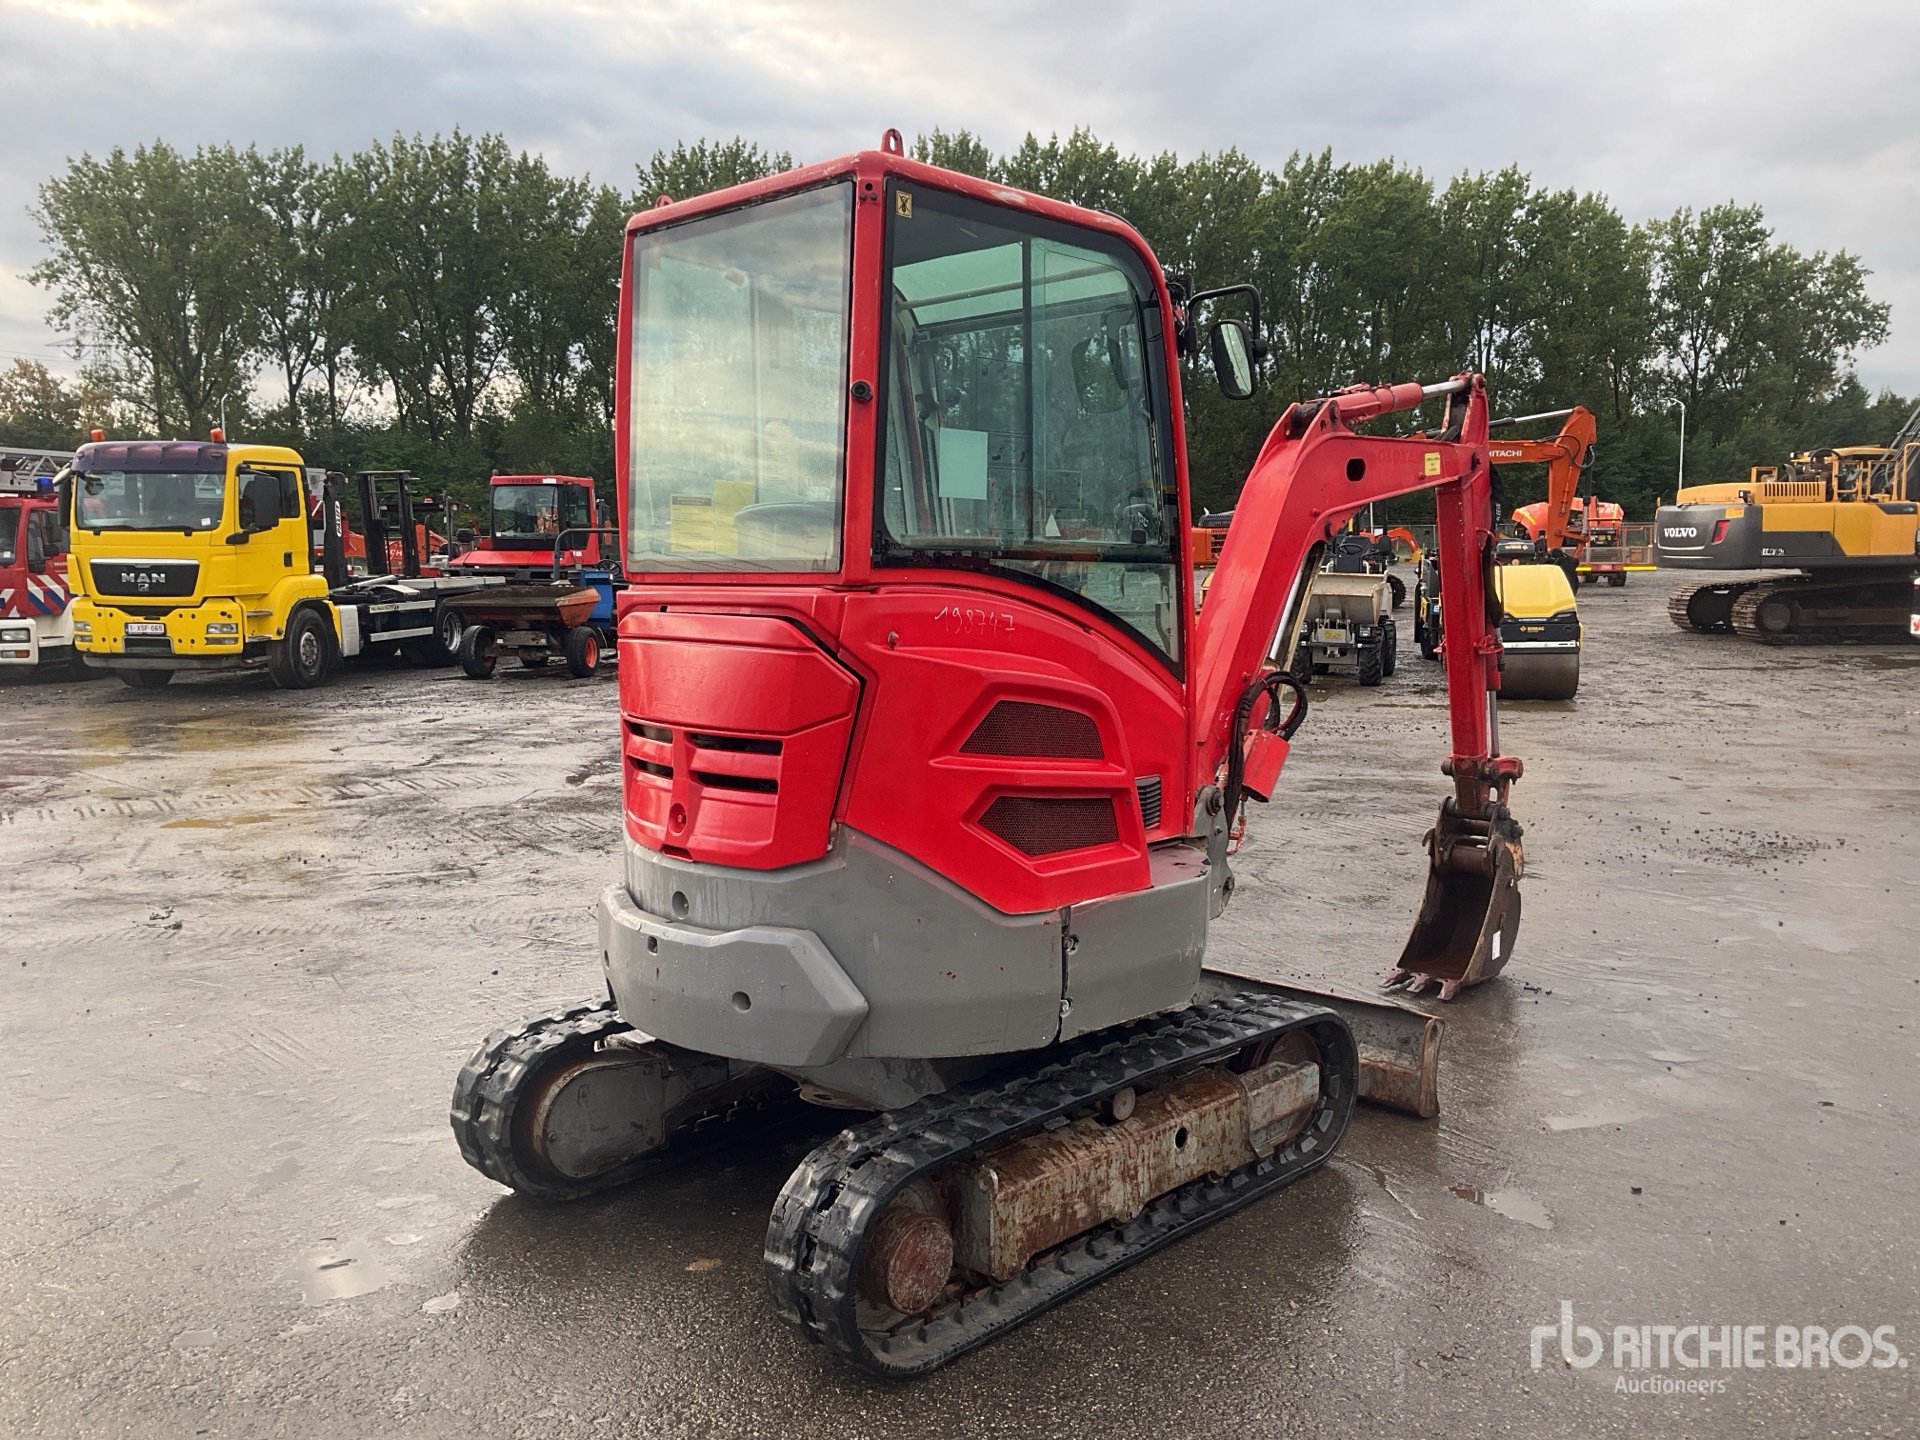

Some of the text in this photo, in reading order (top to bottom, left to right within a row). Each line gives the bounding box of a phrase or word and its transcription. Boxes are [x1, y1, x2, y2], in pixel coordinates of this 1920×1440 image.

[1664, 527, 1697, 538] VOLVO
[121, 572, 166, 583] MAN
[935, 606, 1015, 641] 198747
